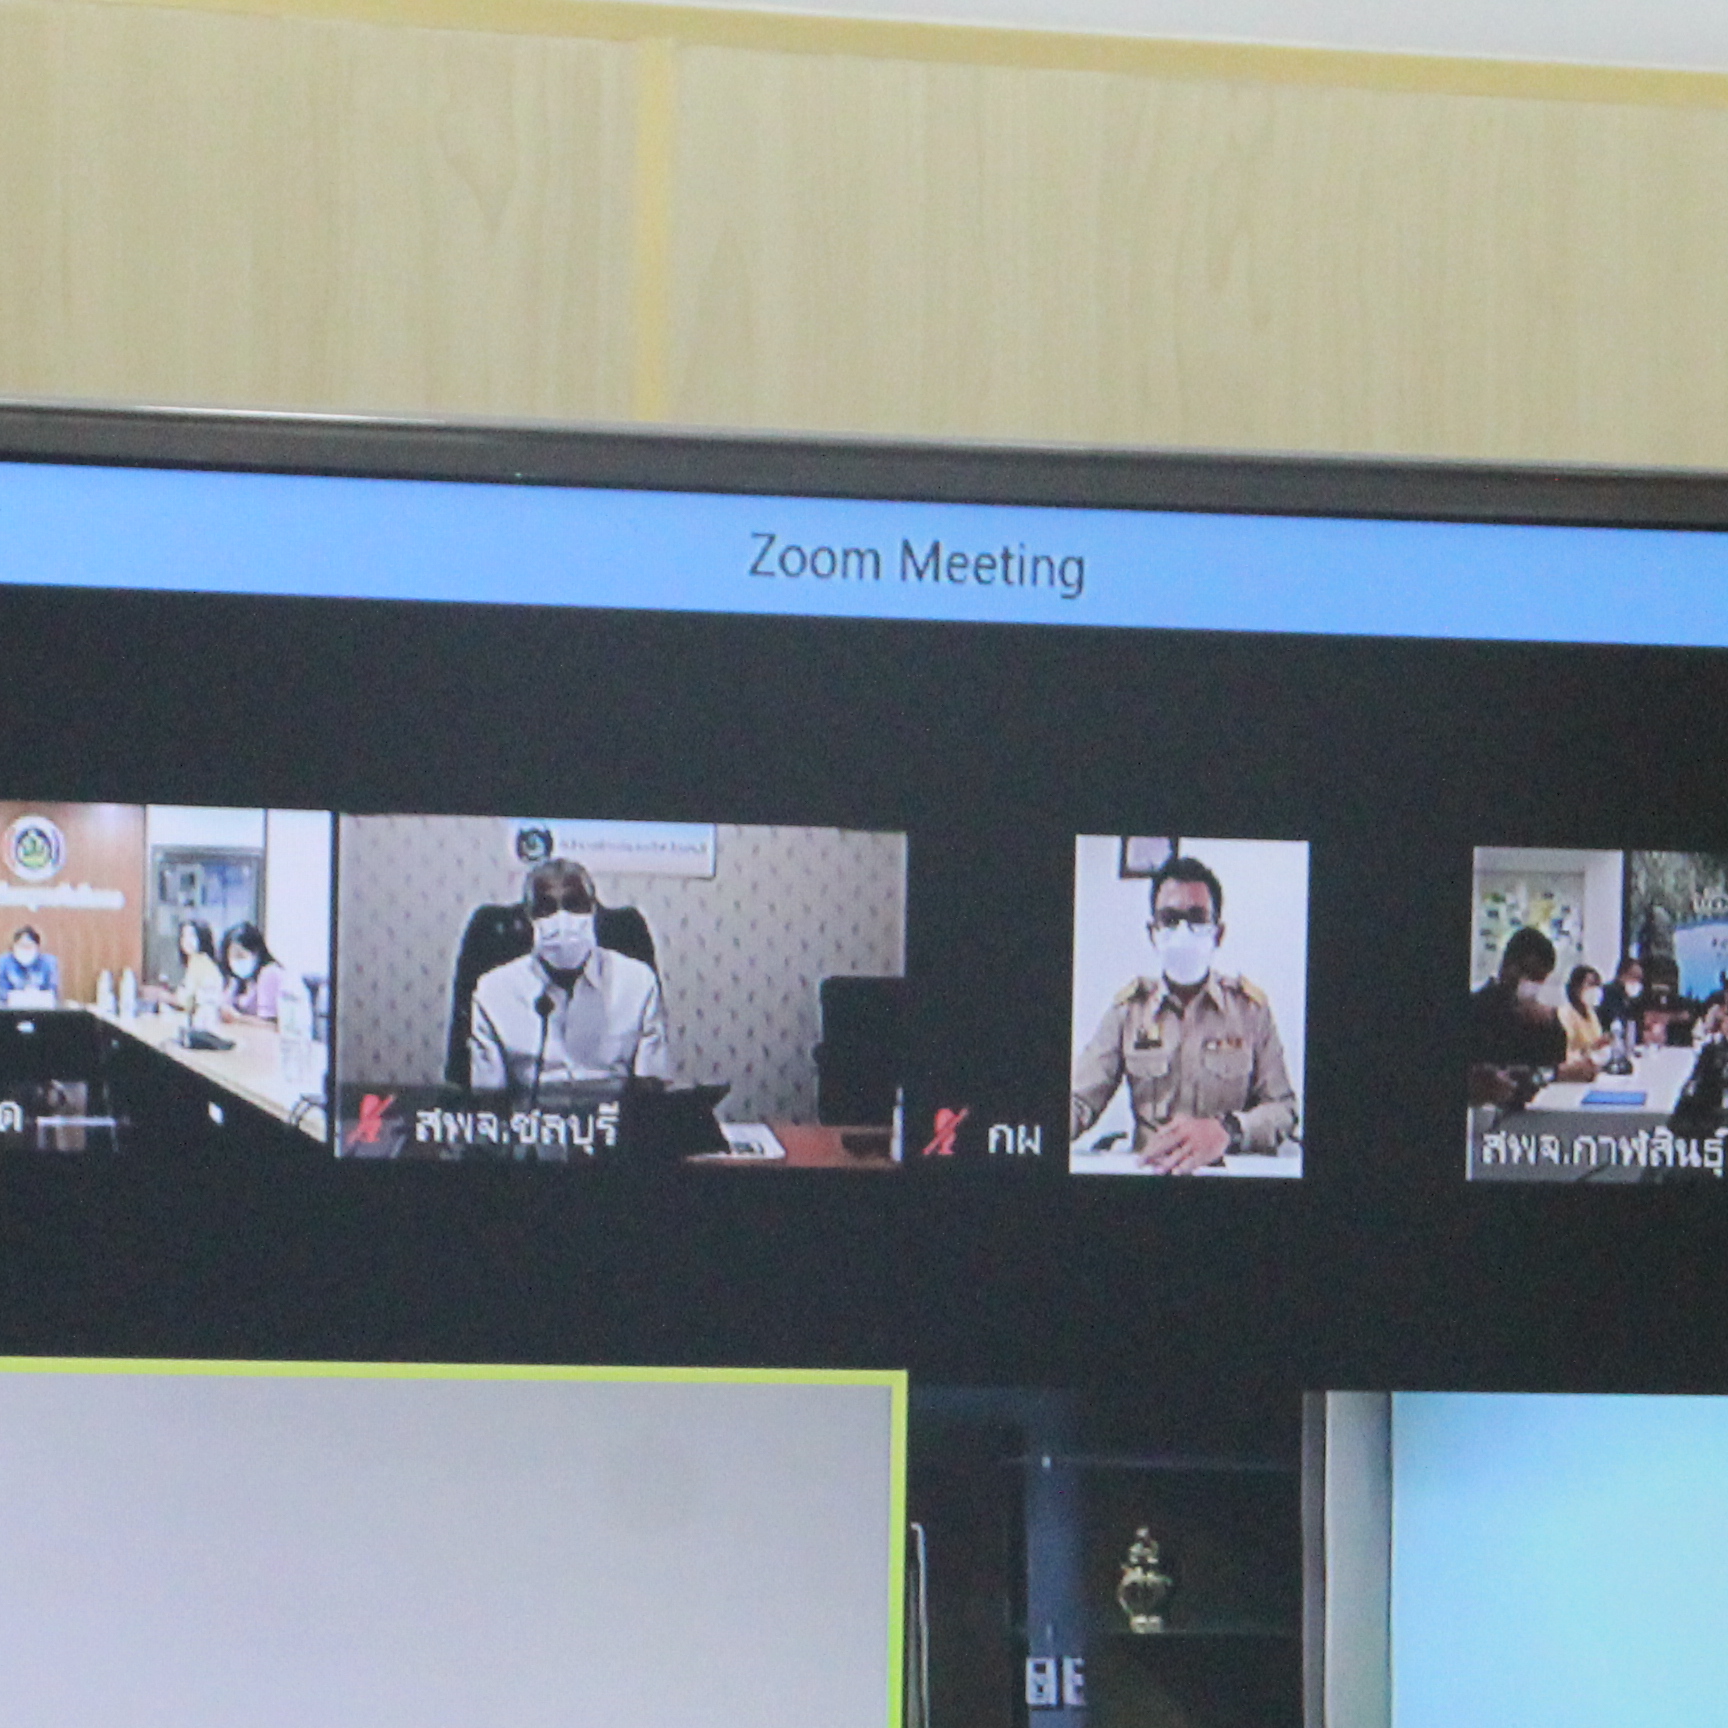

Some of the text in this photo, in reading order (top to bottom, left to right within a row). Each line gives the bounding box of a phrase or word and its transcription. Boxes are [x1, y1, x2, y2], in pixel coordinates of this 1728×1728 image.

[749, 532, 1085, 599] Zoom Meeting
[415, 1101, 620, 1155] สพจ.ชลบุรี
